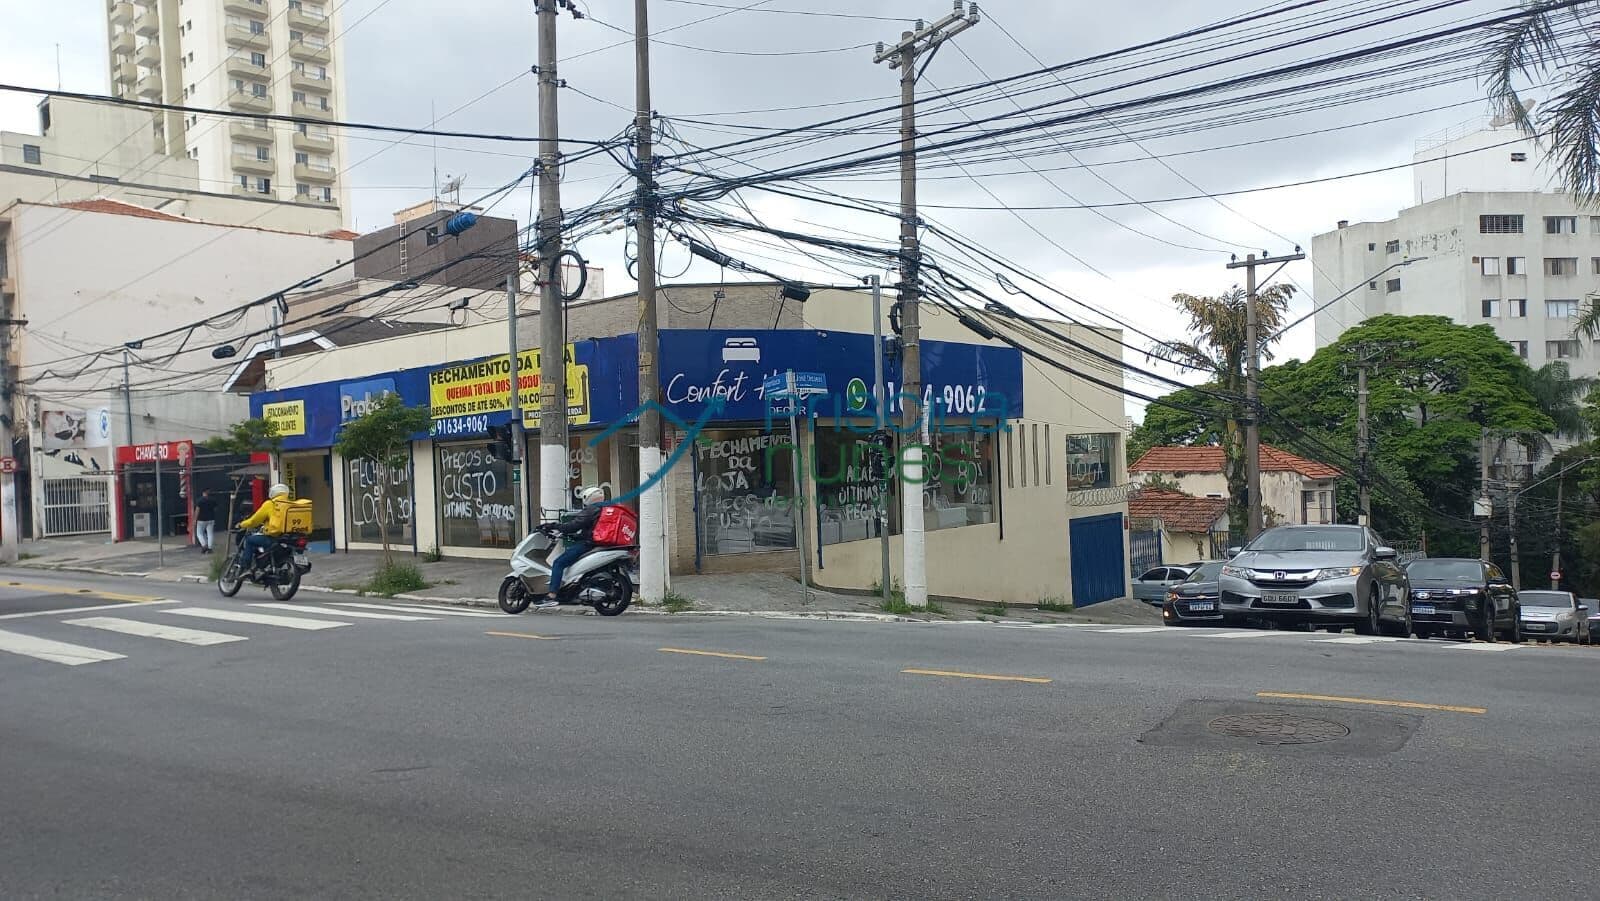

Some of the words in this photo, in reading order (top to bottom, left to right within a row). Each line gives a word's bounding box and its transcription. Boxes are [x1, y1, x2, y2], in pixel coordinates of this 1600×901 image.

[431, 359, 511, 385] FECHAMENTO
[516, 355, 533, 373] DA
[446, 385, 473, 401] QUEIMA
[474, 382, 494, 396] TOTAL
[495, 379, 511, 393] DOS
[468, 401, 476, 412] DE
[436, 415, 488, 435] 91634-9062
[135, 444, 168, 461] CHAVERO
[443, 470, 497, 500] CUSTO
